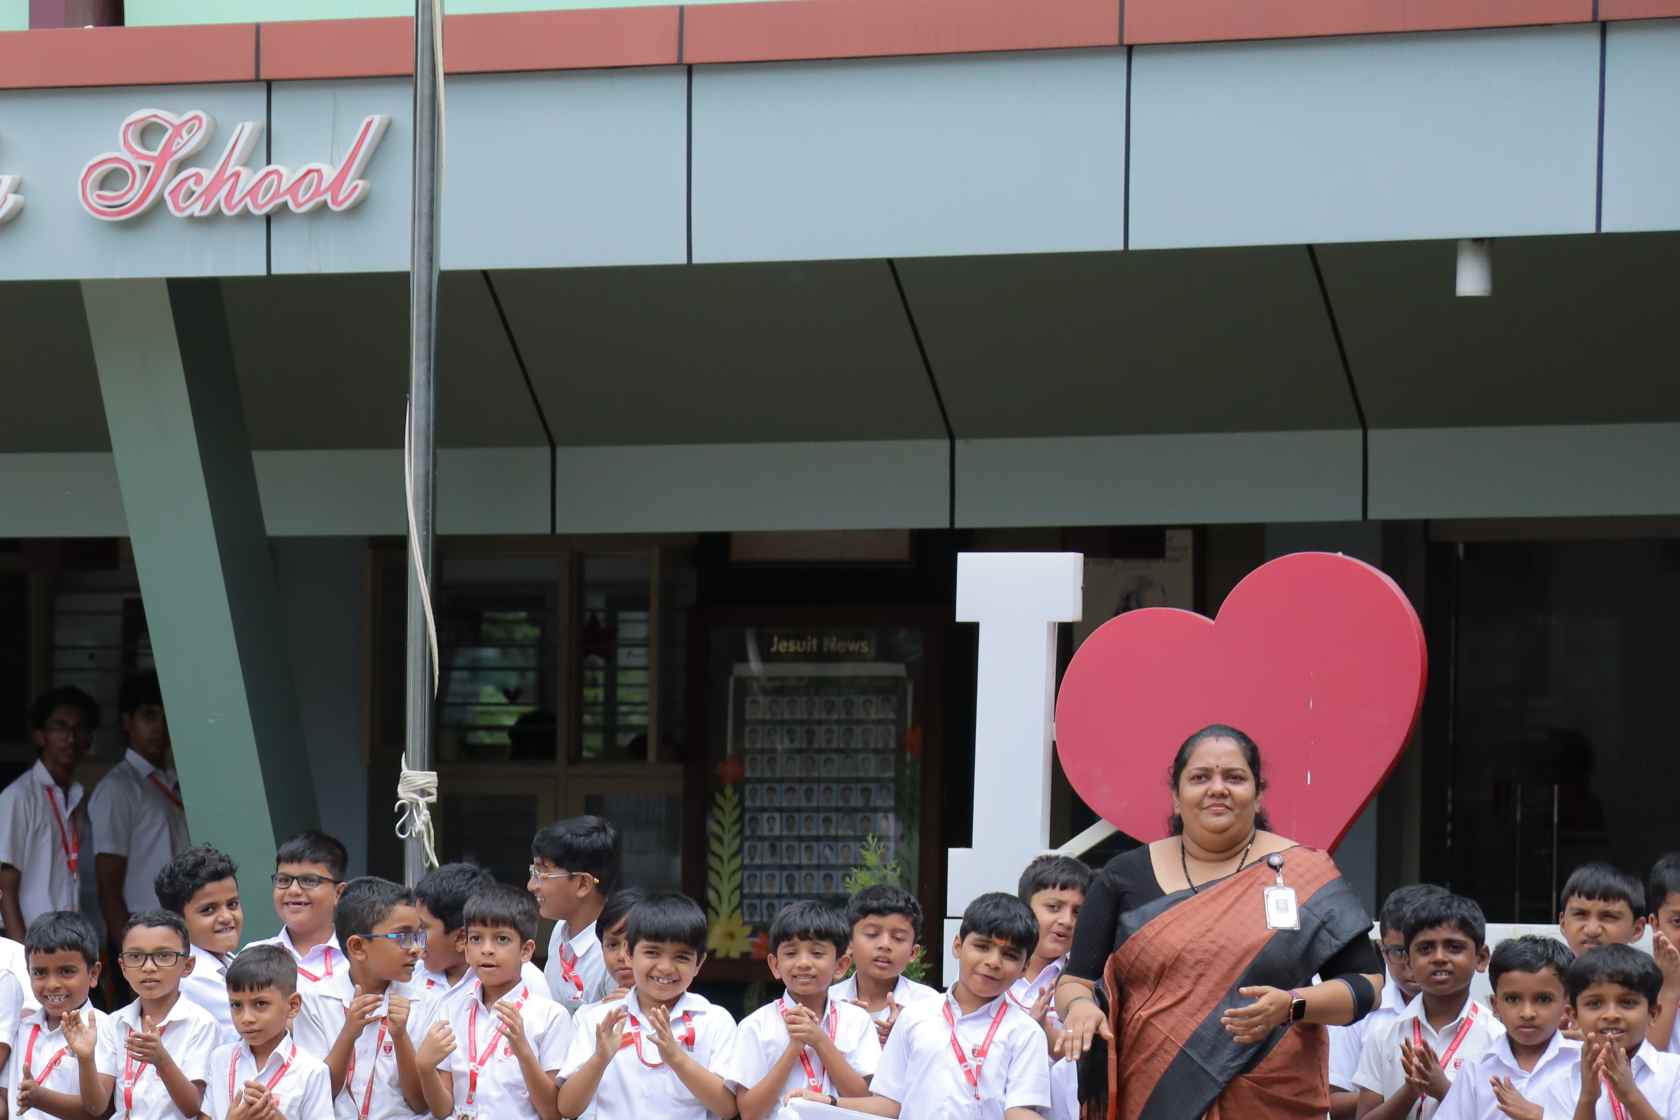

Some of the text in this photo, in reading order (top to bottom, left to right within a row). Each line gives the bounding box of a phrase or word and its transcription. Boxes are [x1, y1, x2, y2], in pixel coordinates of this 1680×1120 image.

[79, 108, 392, 222] School
[769, 634, 870, 654] Jesuit News
